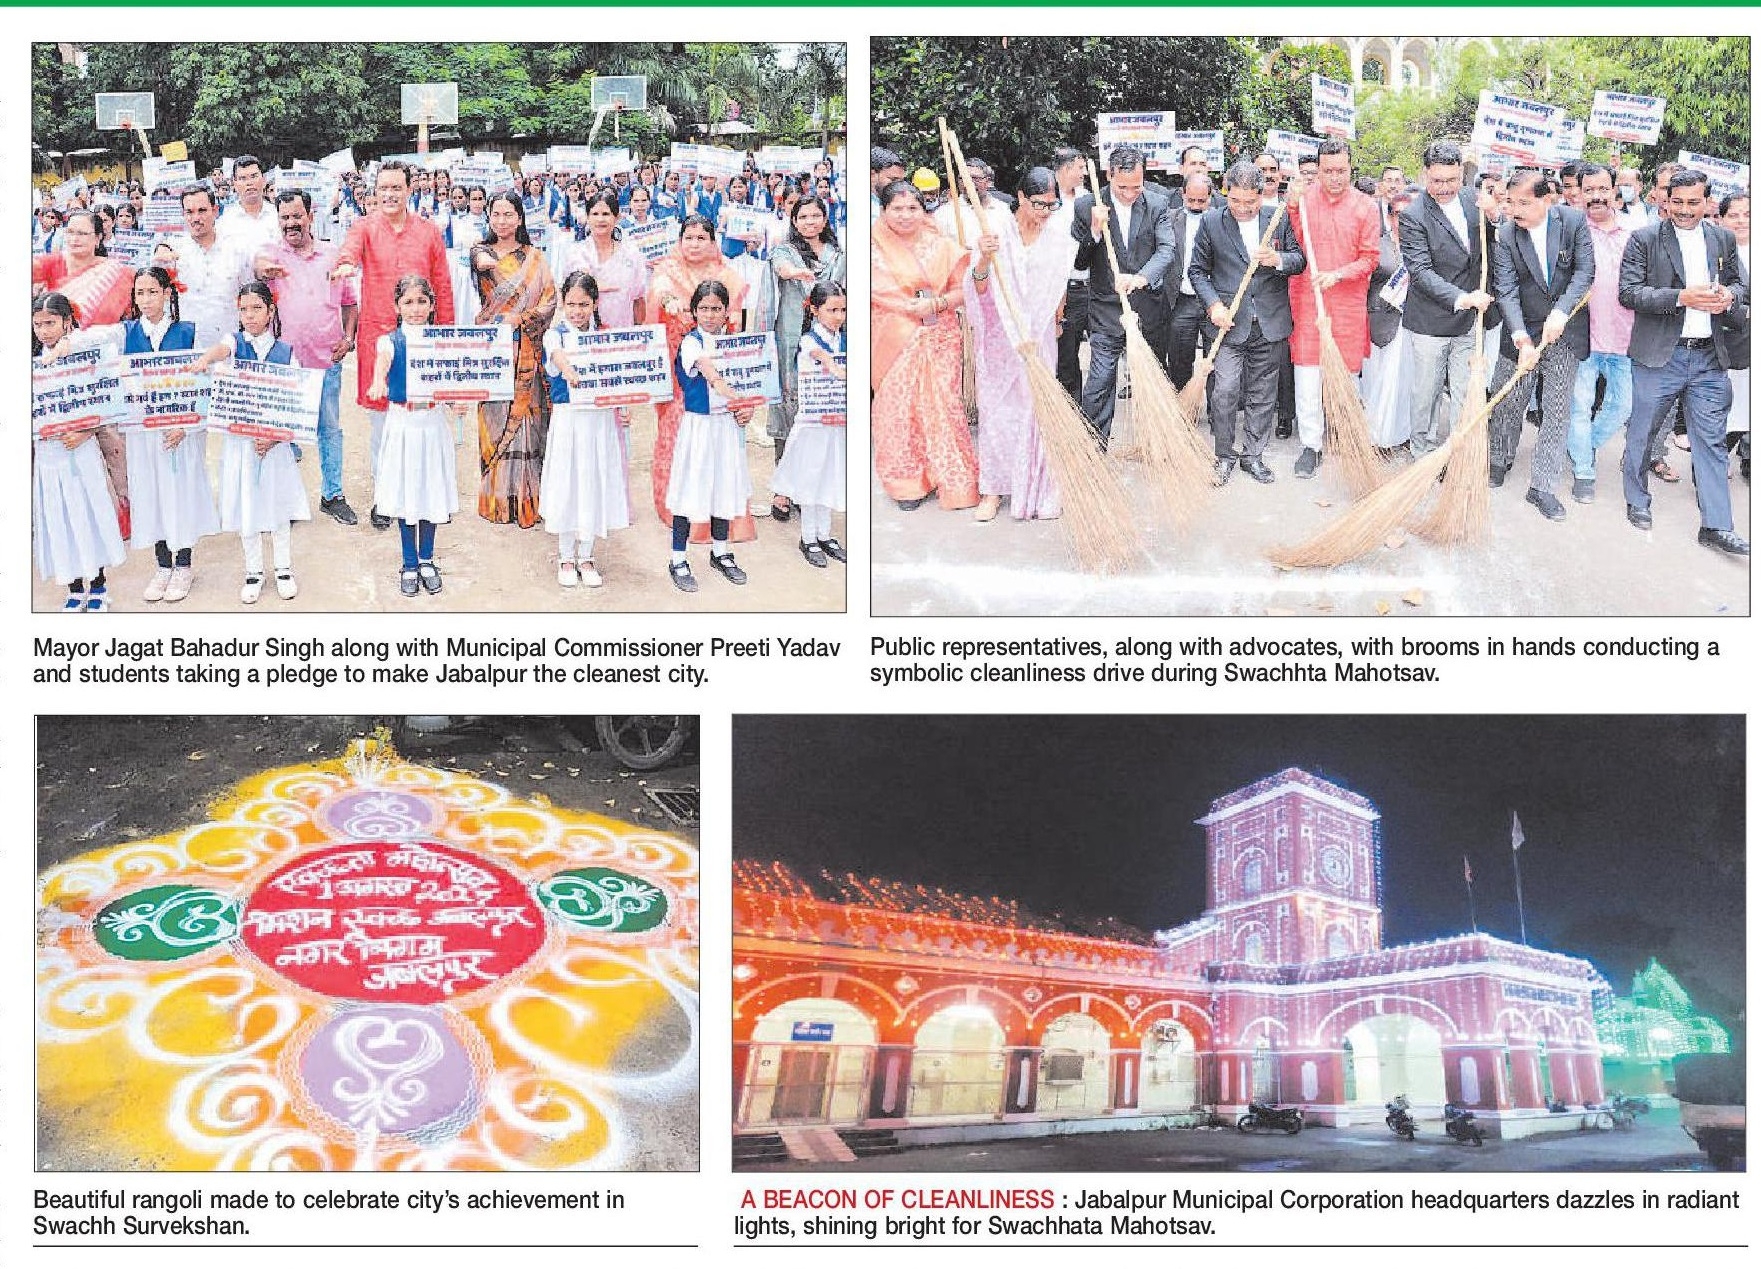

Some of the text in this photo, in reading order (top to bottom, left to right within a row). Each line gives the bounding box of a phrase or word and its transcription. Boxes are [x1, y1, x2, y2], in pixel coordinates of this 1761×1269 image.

[423, 327, 498, 343] आभार जबलपुर
[34, 637, 841, 662] Mayor Jagat Bahadur Singh along with Municipal Commissioner Preeti Yadav
[871, 636, 1721, 661] Public representatives, along with advocates, with brooms in hands conducting a
[33, 663, 709, 688] and students taking a pledge to make Jabalpur the cleanest city.
[870, 662, 1440, 687] symbolic cleanliness drive during Swachhta Mahotsav.
[34, 1189, 625, 1214] Beautiful rangoli made to celebrate city’s achievement in
[740, 1189, 757, 1209] A
[764, 1189, 857, 1210] BEACON
[864, 1189, 895, 1209] OF
[901, 1189, 1055, 1209] CLEANLINESS
[1074, 1189, 1167, 1214] Jabalpur
[1173, 1189, 1273, 1214] Municipal
[1280, 1189, 1404, 1214] Corporation
[1411, 1189, 1550, 1214] headquarters
[1556, 1189, 1635, 1209] dazzles
[1642, 1189, 1660, 1209] in
[1667, 1189, 1740, 1209] radiant
[33, 1215, 250, 1236] Swachh Survekshan.
[734, 1215, 1216, 1240] lights, shining bright for Swachhata Mahotsav.
